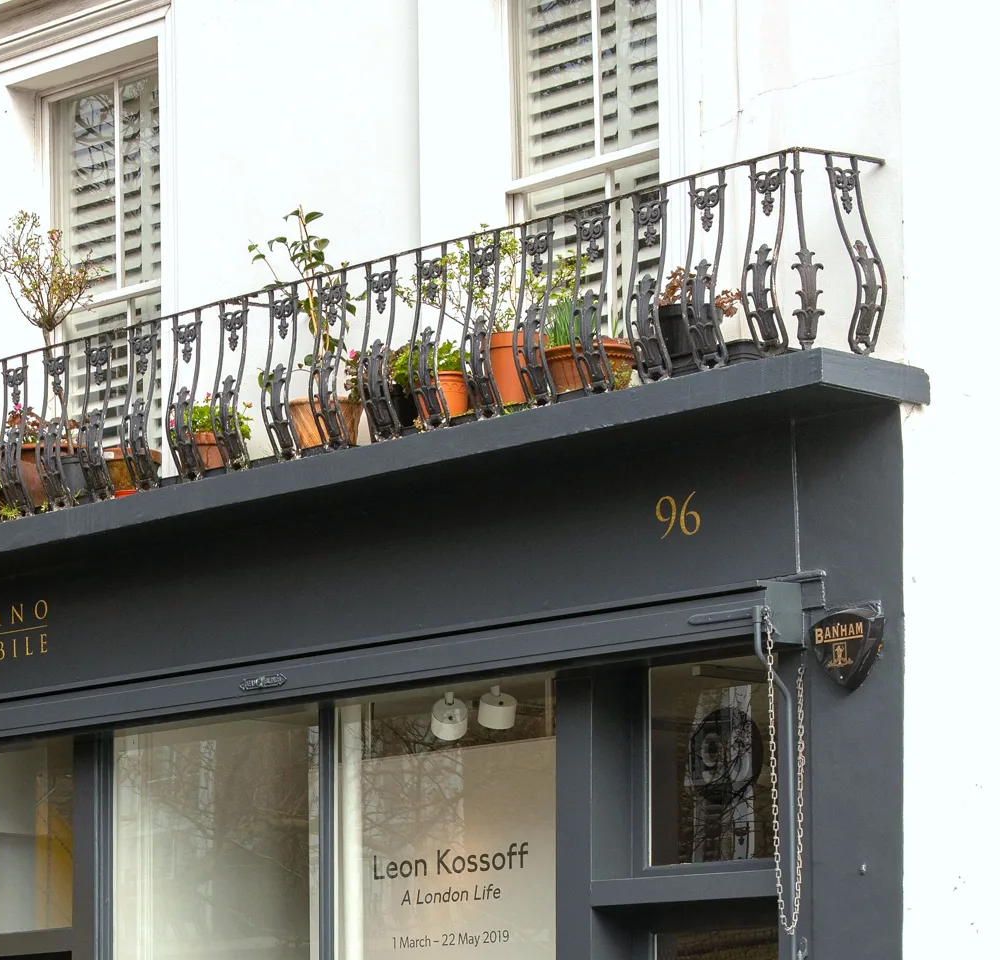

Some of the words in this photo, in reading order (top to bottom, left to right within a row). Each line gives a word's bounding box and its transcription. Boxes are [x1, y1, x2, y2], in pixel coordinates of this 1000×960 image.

[655, 491, 701, 540] 96
[815, 621, 863, 645] BANHAM
[373, 855, 428, 880] Leon
[436, 841, 529, 875] Kossoff
[400, 889, 412, 906] A
[416, 886, 469, 905] London
[473, 883, 501, 901] Life
[392, 936, 397, 949] 1
[399, 934, 431, 949] March
[441, 933, 456, 946] 22
[457, 932, 481, 948] May
[482, 929, 510, 944] 2019
